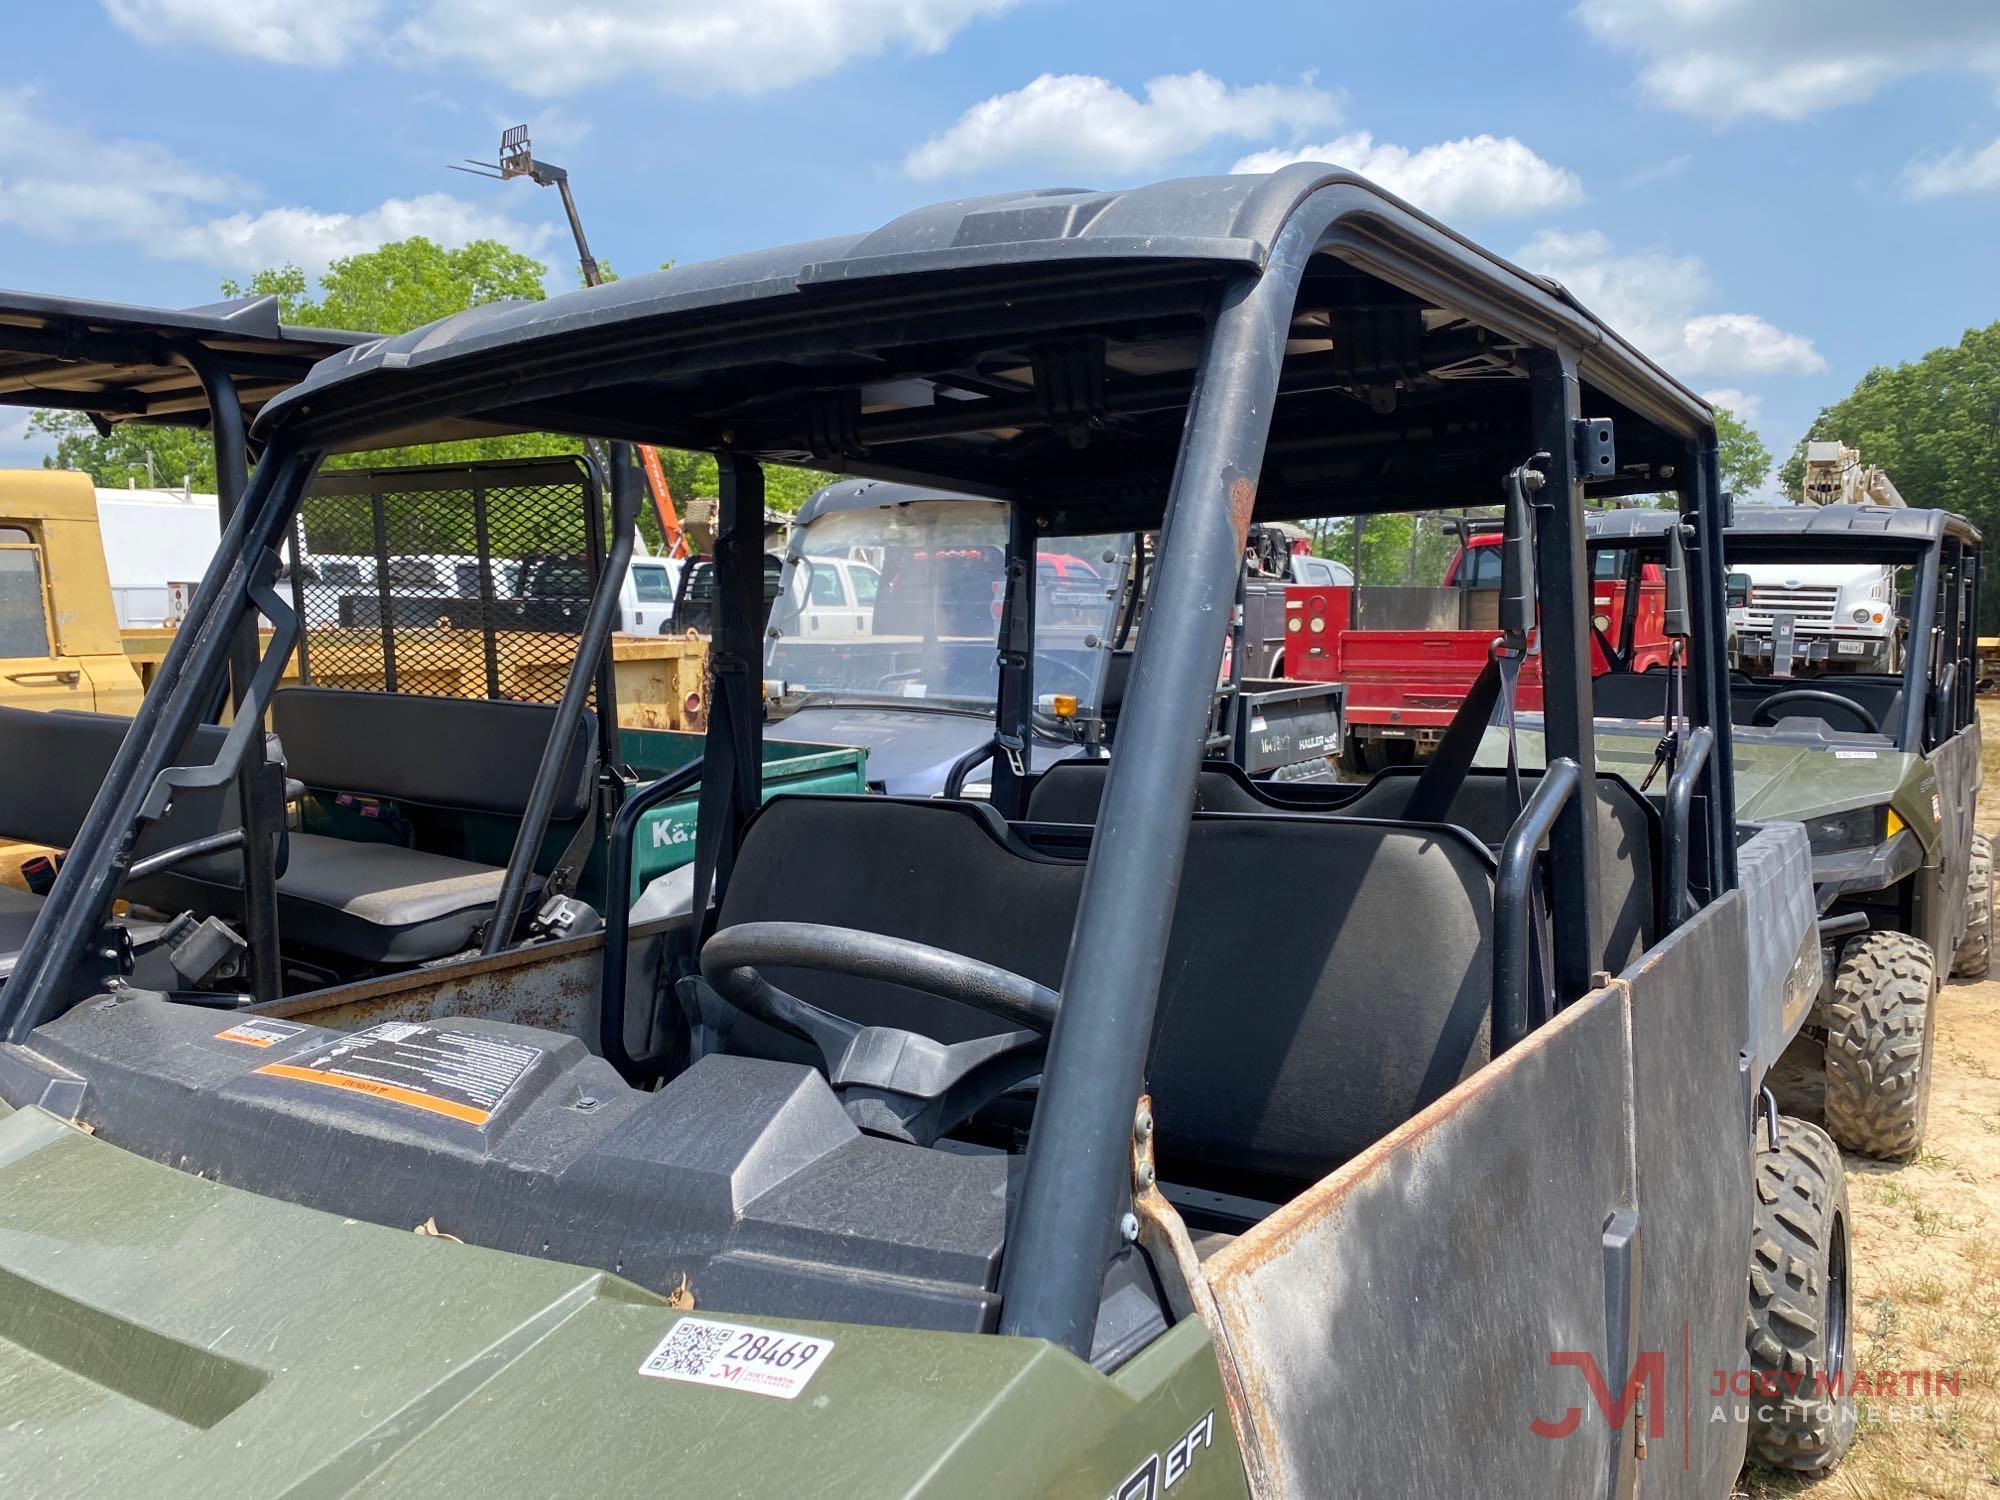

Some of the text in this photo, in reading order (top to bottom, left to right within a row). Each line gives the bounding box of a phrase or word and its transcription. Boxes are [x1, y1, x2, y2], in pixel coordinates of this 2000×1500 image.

[724, 1333, 819, 1370] 28469
[747, 1371, 795, 1385] JOEY MARTIN
[1164, 1409, 1214, 1490] EFI
